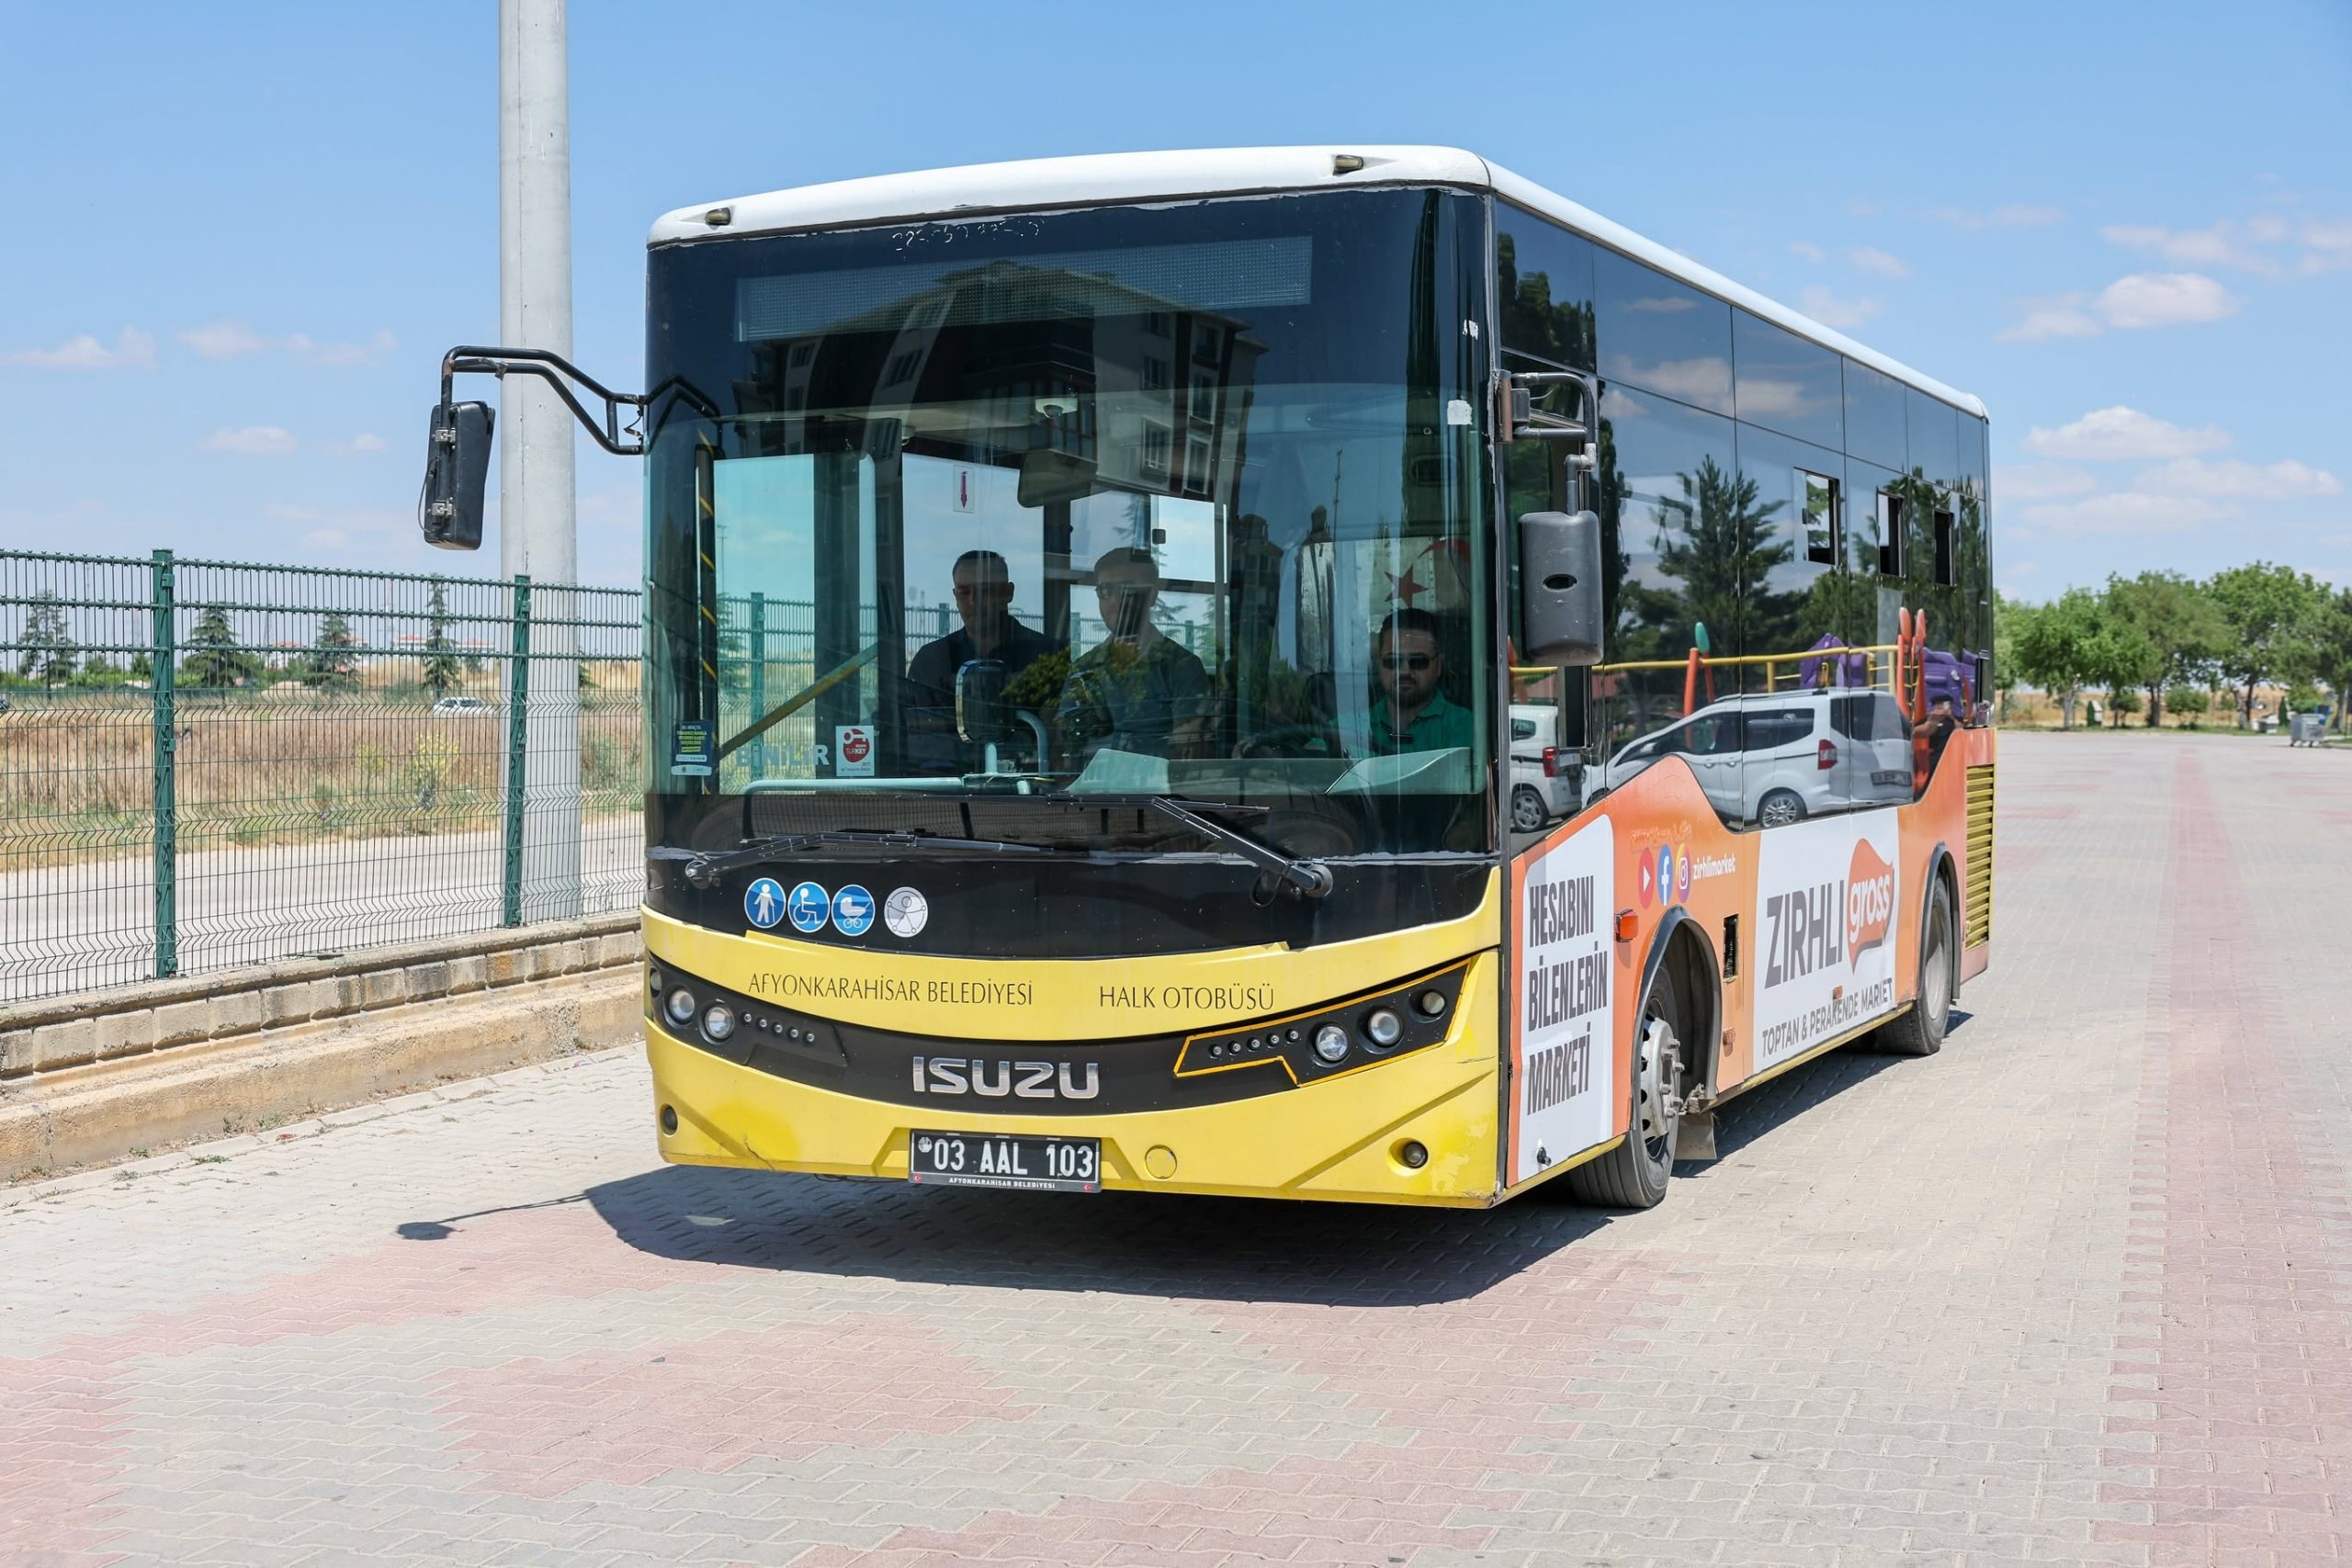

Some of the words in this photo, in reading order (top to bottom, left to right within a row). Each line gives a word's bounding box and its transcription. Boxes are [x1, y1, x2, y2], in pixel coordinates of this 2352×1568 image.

[1693, 852, 1736, 881] zirhlimarket
[1529, 874, 1594, 949] HESABINI
[1764, 879, 1845, 989] ZIRHLI
[1849, 874, 1892, 944] gross
[748, 973, 922, 1002] AFYONKARAHİSAR
[927, 977, 1034, 1006] BELEDİYESİ
[1100, 985, 1157, 1009] HALK
[1162, 982, 1274, 1010] OTOBÜSÜ
[1528, 940, 1608, 1032] BİLENLERİN
[1761, 1016, 1800, 1058] TOPTAN
[1801, 1011, 1808, 1041] &
[1809, 991, 1860, 1038] PERAKENDE
[912, 1055, 1100, 1100] ISUZU
[1526, 1021, 1591, 1116] MARKETİ
[933, 1138, 966, 1171] 03
[979, 1140, 1028, 1176] AAL
[1046, 1144, 1094, 1179] 103
[948, 1177, 1012, 1188] AFYONKARAHİSAR
[1013, 1180, 1057, 1190] BELEDİYESİ
